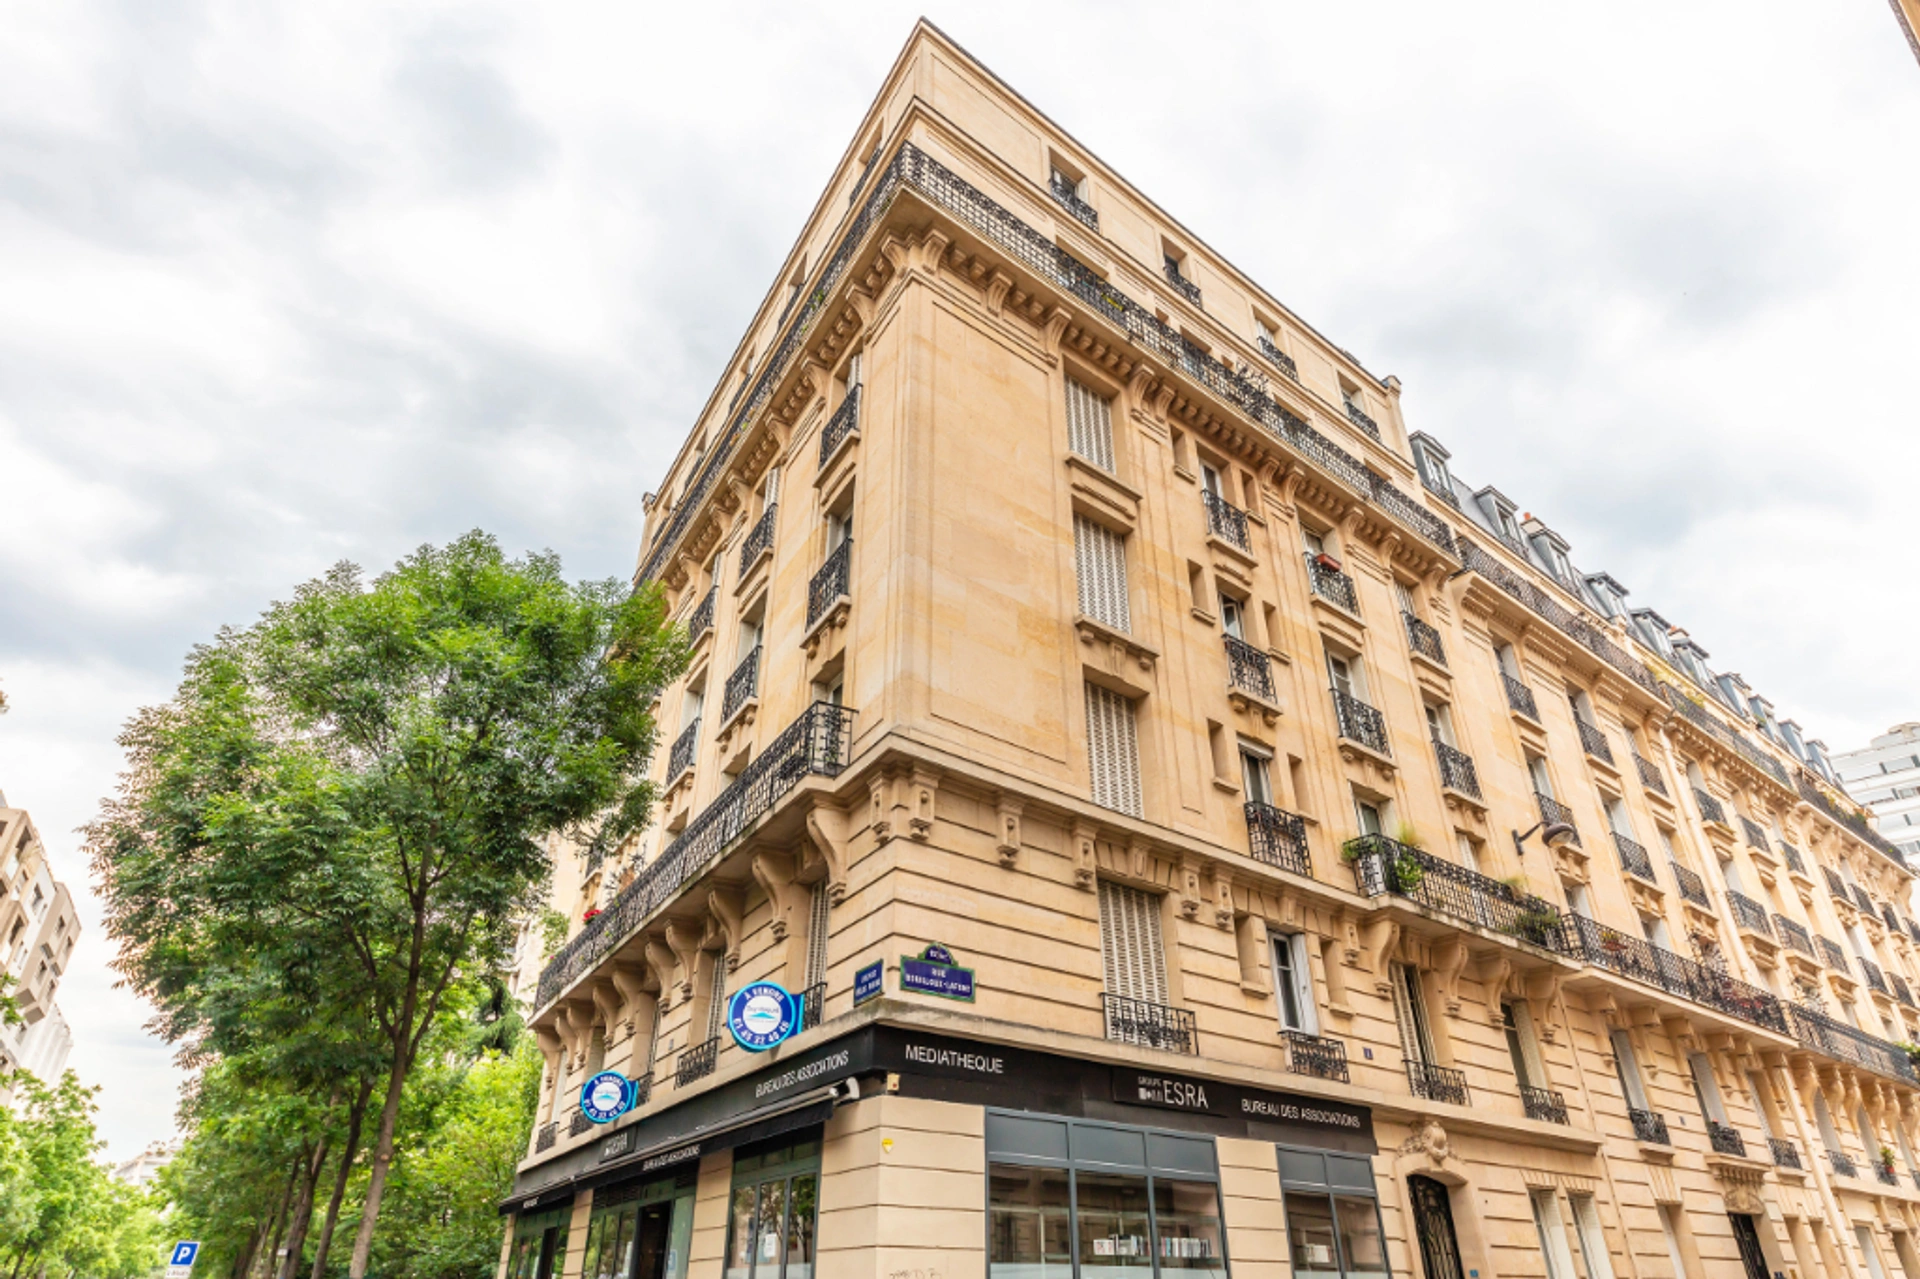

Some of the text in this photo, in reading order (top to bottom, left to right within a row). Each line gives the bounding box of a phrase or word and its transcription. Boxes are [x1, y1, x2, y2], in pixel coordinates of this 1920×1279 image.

[931, 967, 947, 978] RUE
[752, 986, 784, 1002] VENDRE
[905, 1044, 1004, 1074] MEDIATHEQUE
[755, 1078, 781, 1098] BUREAU
[797, 1050, 848, 1081] ASSOCIATIONS
[1163, 1080, 1209, 1109] ESRA
[1241, 1098, 1361, 1128] BUREAU DES ASSOCIATIONS
[176, 1246, 191, 1262] P
